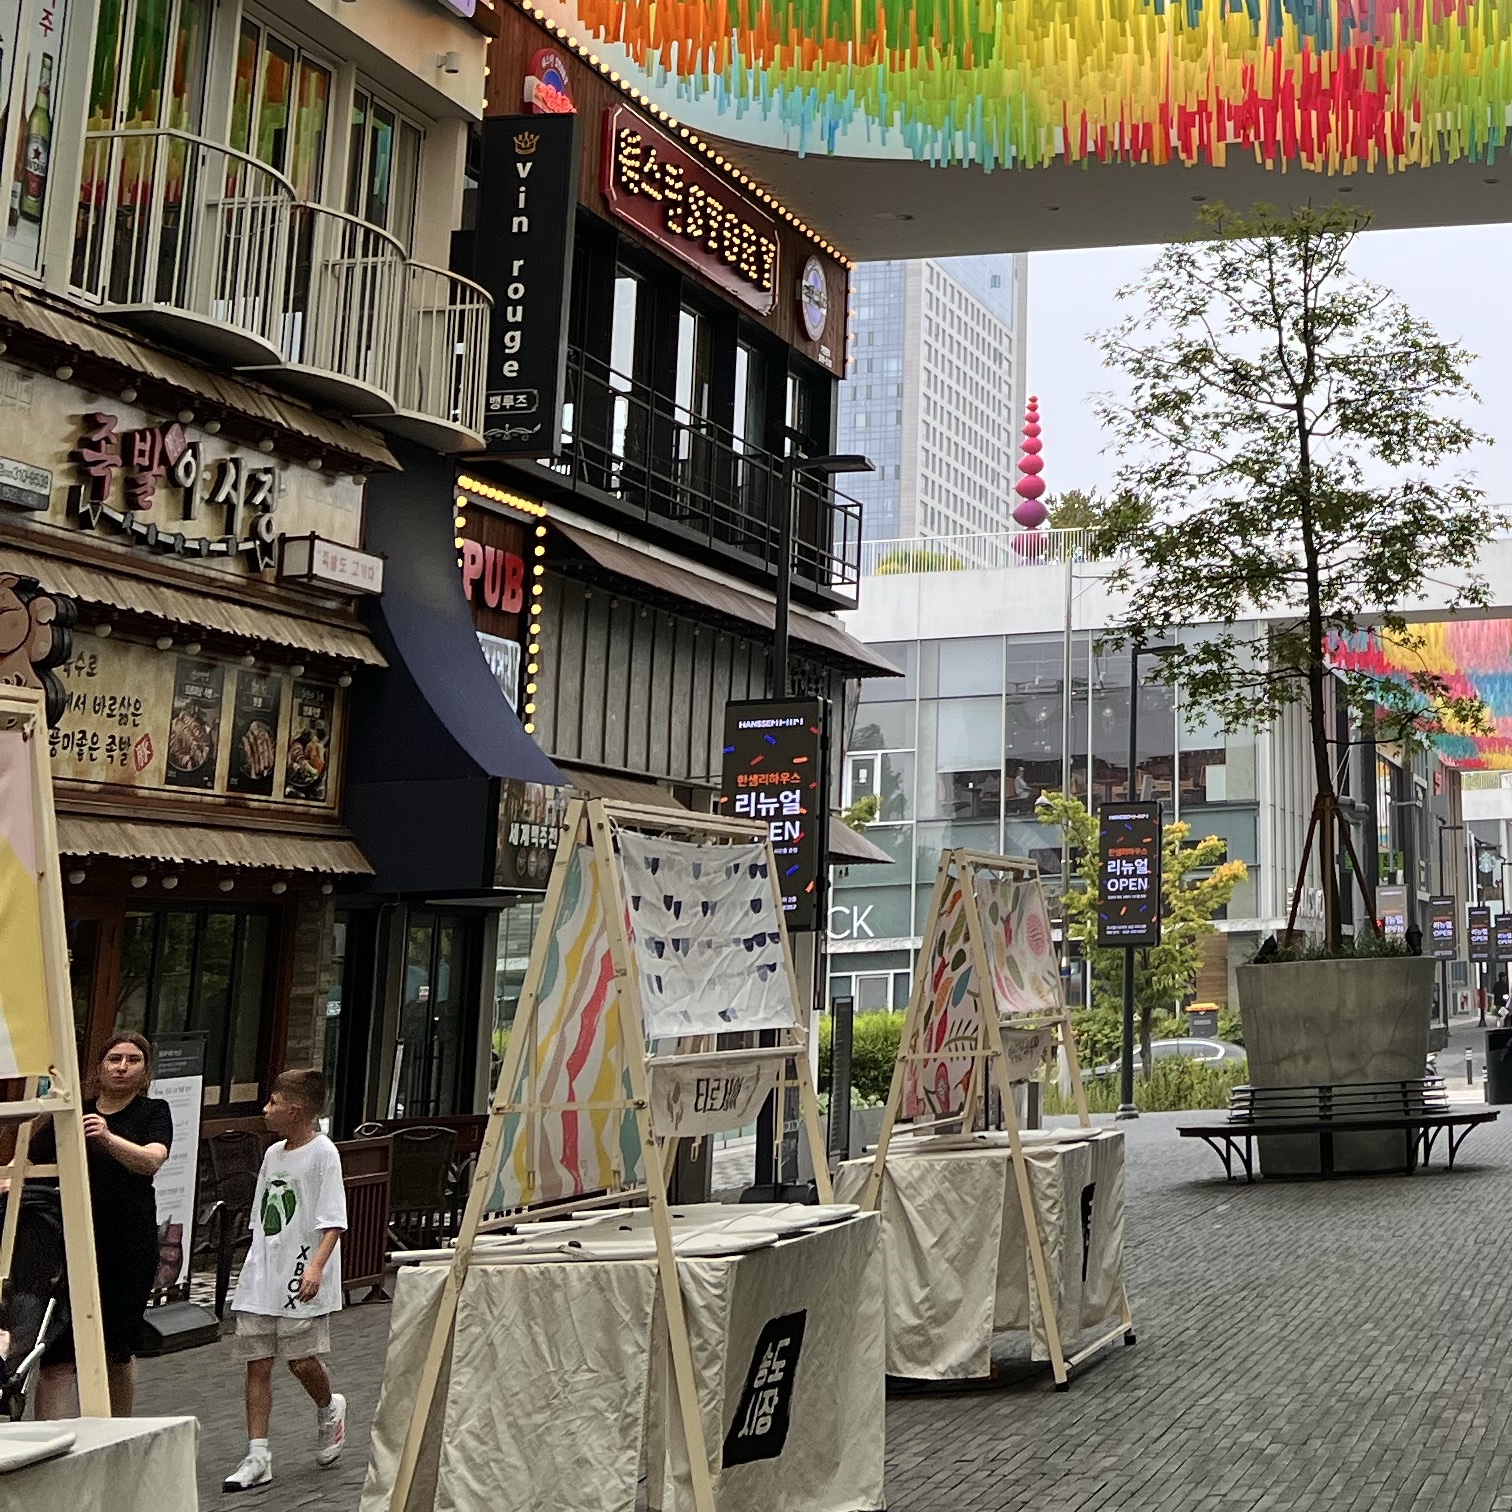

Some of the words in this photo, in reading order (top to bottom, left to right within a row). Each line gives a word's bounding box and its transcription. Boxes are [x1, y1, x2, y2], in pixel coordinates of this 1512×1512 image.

[511, 161, 533, 233] vin
[502, 258, 525, 378] rouge
[462, 538, 526, 615] PUB
[105, 734, 132, 766] 족발
[735, 789, 801, 818] 리뉴얼
[1107, 857, 1149, 876] 리뉴얼
[1107, 877, 1149, 892] OPEN
[284, 1244, 311, 1310] XBOX
